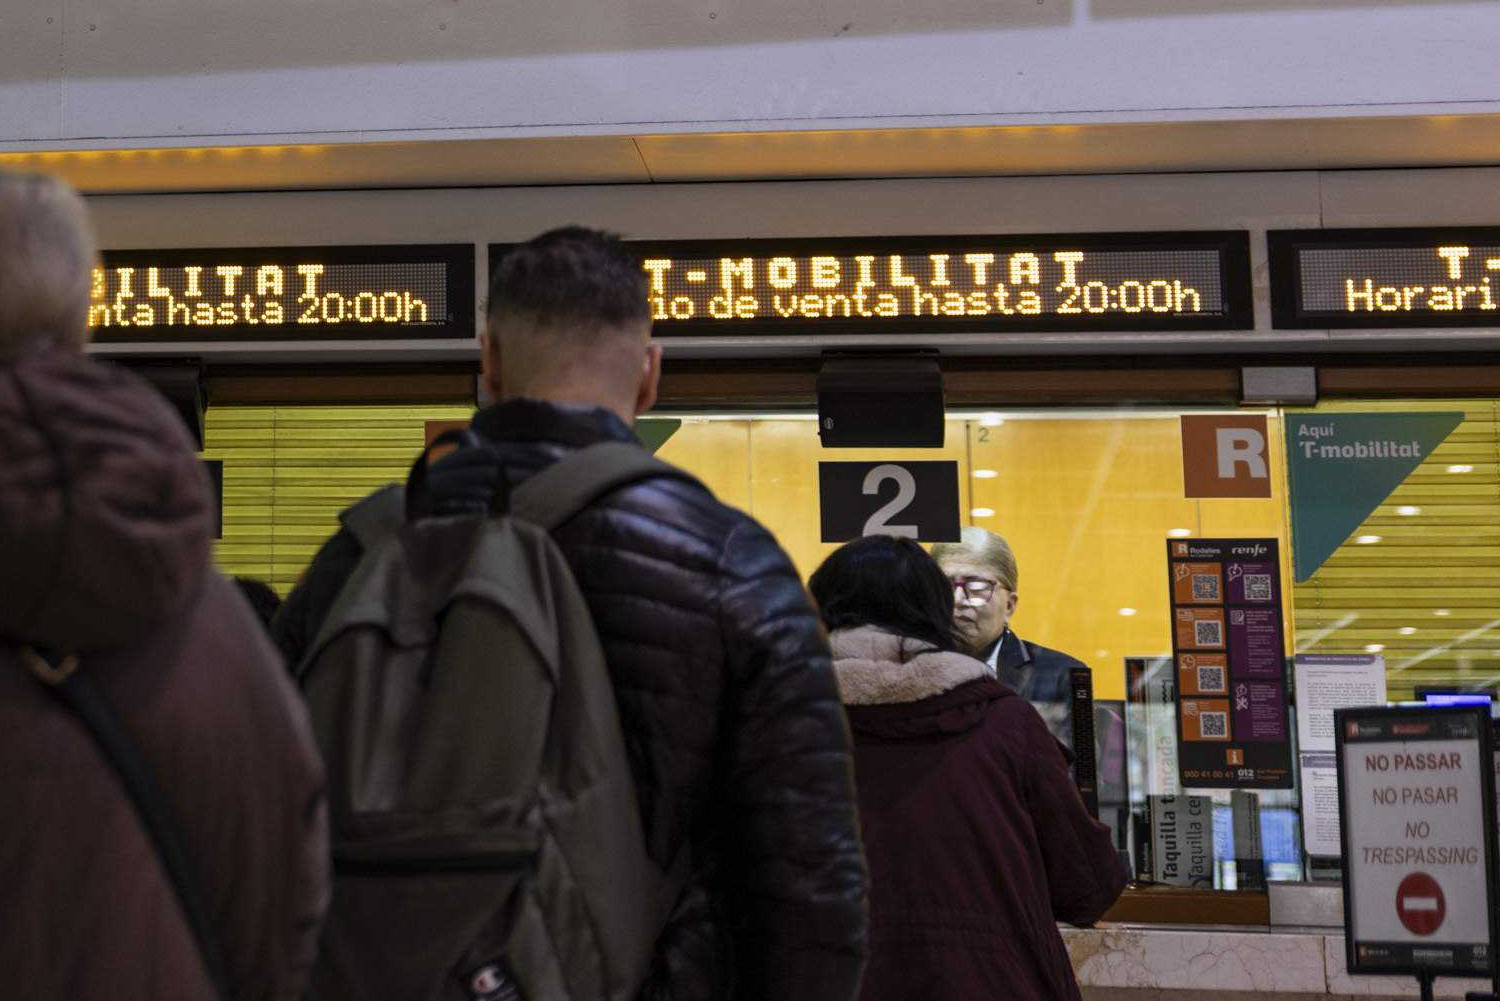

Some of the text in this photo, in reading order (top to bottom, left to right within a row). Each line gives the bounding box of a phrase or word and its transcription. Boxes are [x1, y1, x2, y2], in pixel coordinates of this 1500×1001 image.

[644, 252, 1084, 294] T-MOBILITAT
[168, 294, 283, 326] hasta
[298, 291, 427, 324] 20:00h
[709, 280, 1200, 319] de venta hasta 20:00h
[1345, 277, 1497, 312] Horari
[1298, 423, 1334, 440] Aquí
[1216, 428, 1268, 478] R
[1299, 441, 1421, 459] T-mobilitat
[862, 464, 919, 539] 2
[1365, 752, 1461, 773] NO PASSAR
[1373, 786, 1458, 805] NO PASAR
[1160, 811, 1181, 880] Taquilla
[1405, 821, 1430, 838] NO
[1186, 822, 1206, 880] Taquilla
[1362, 847, 1478, 866] TRESPASSING
